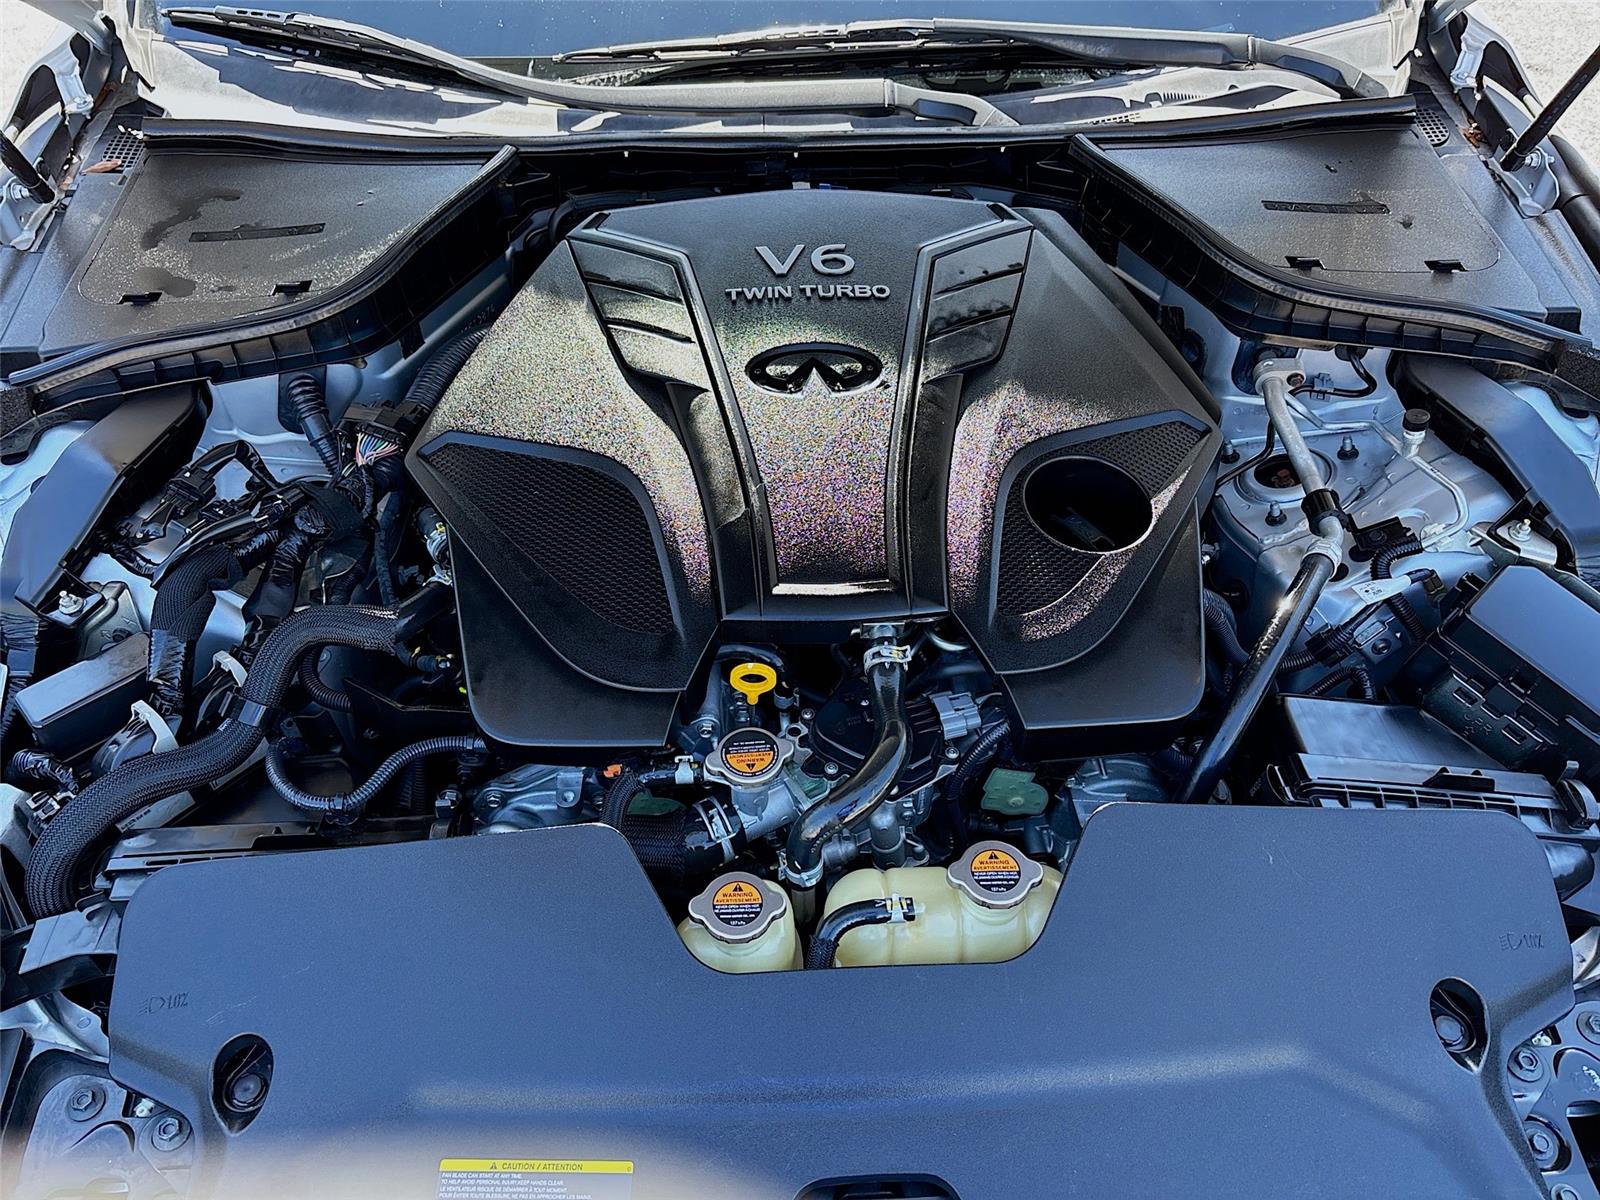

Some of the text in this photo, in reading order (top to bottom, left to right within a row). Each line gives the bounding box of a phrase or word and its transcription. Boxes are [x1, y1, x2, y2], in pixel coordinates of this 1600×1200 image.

[755, 243, 856, 276] V6
[725, 284, 891, 301] TWIN TURBO
[502, 1162, 535, 1170] CAUTION
[542, 1162, 583, 1171] ATTENTION
